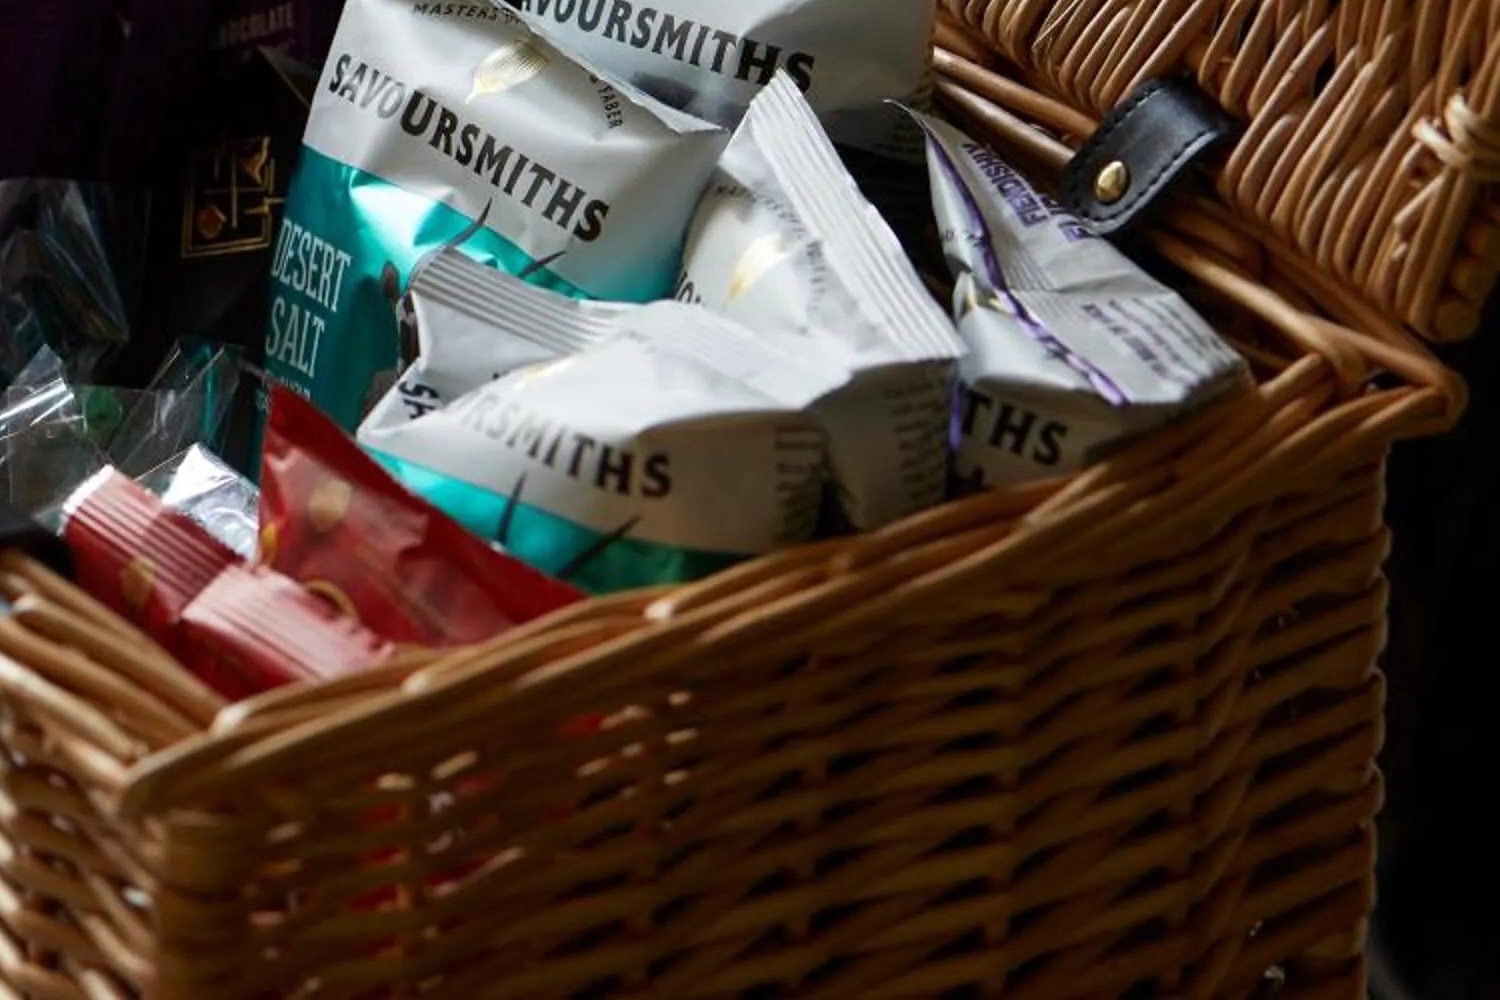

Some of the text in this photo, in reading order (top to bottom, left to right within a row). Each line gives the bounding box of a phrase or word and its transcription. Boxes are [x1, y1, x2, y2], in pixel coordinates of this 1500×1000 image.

[412, 2, 498, 22] MASTERS
[328, 53, 611, 242] SAVOURSMITHS
[270, 218, 352, 314] DESERT
[265, 301, 326, 378] SALT
